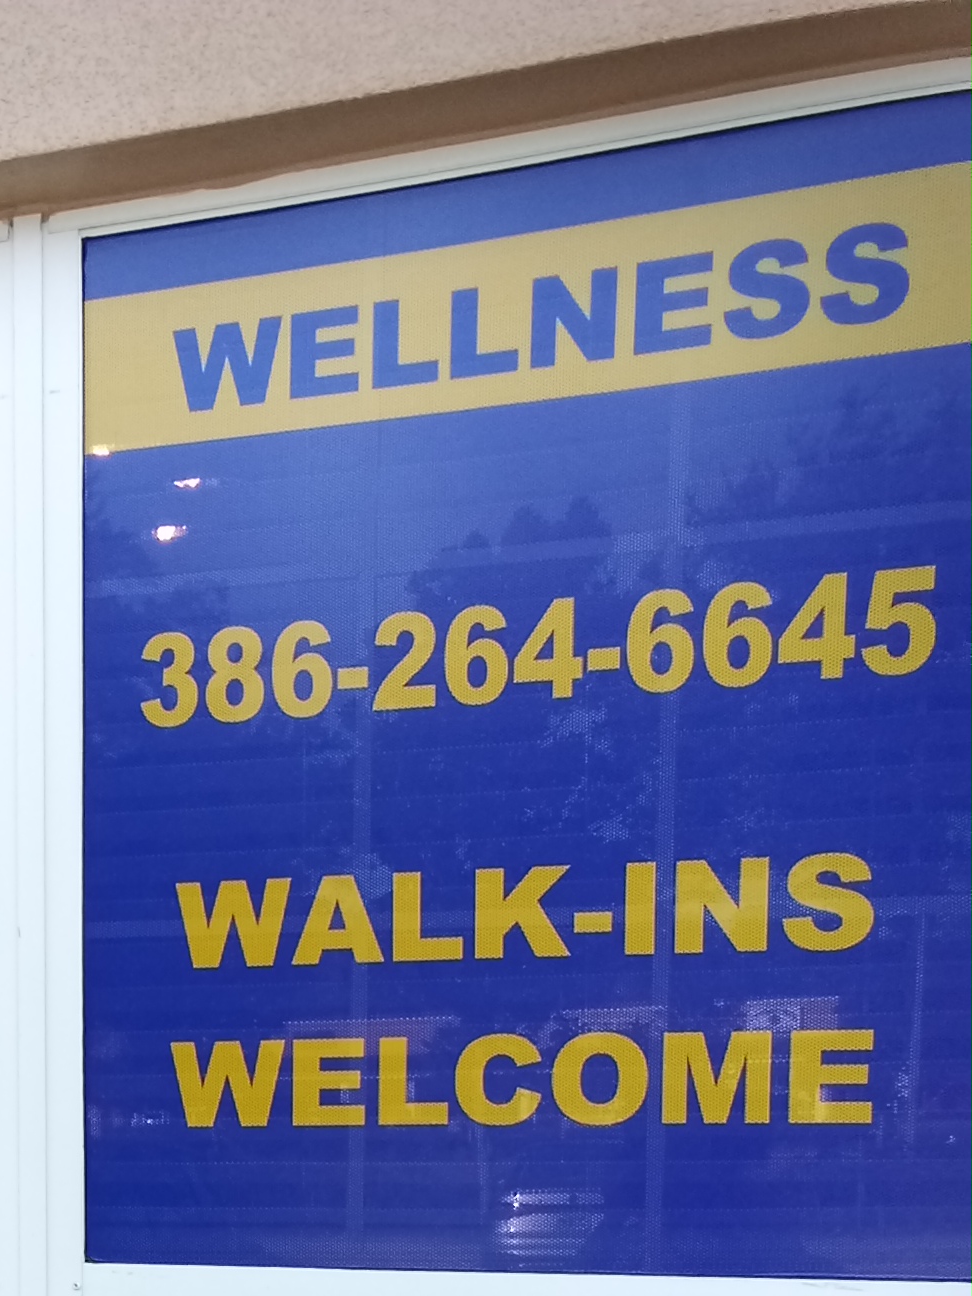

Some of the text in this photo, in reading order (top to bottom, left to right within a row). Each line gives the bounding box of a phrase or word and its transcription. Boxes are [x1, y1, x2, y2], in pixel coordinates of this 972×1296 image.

[173, 222, 910, 412] WELLNESS
[140, 565, 936, 727] 386-264-6645
[176, 852, 875, 968] WALK-INS
[169, 1028, 875, 1127] WELCOME
